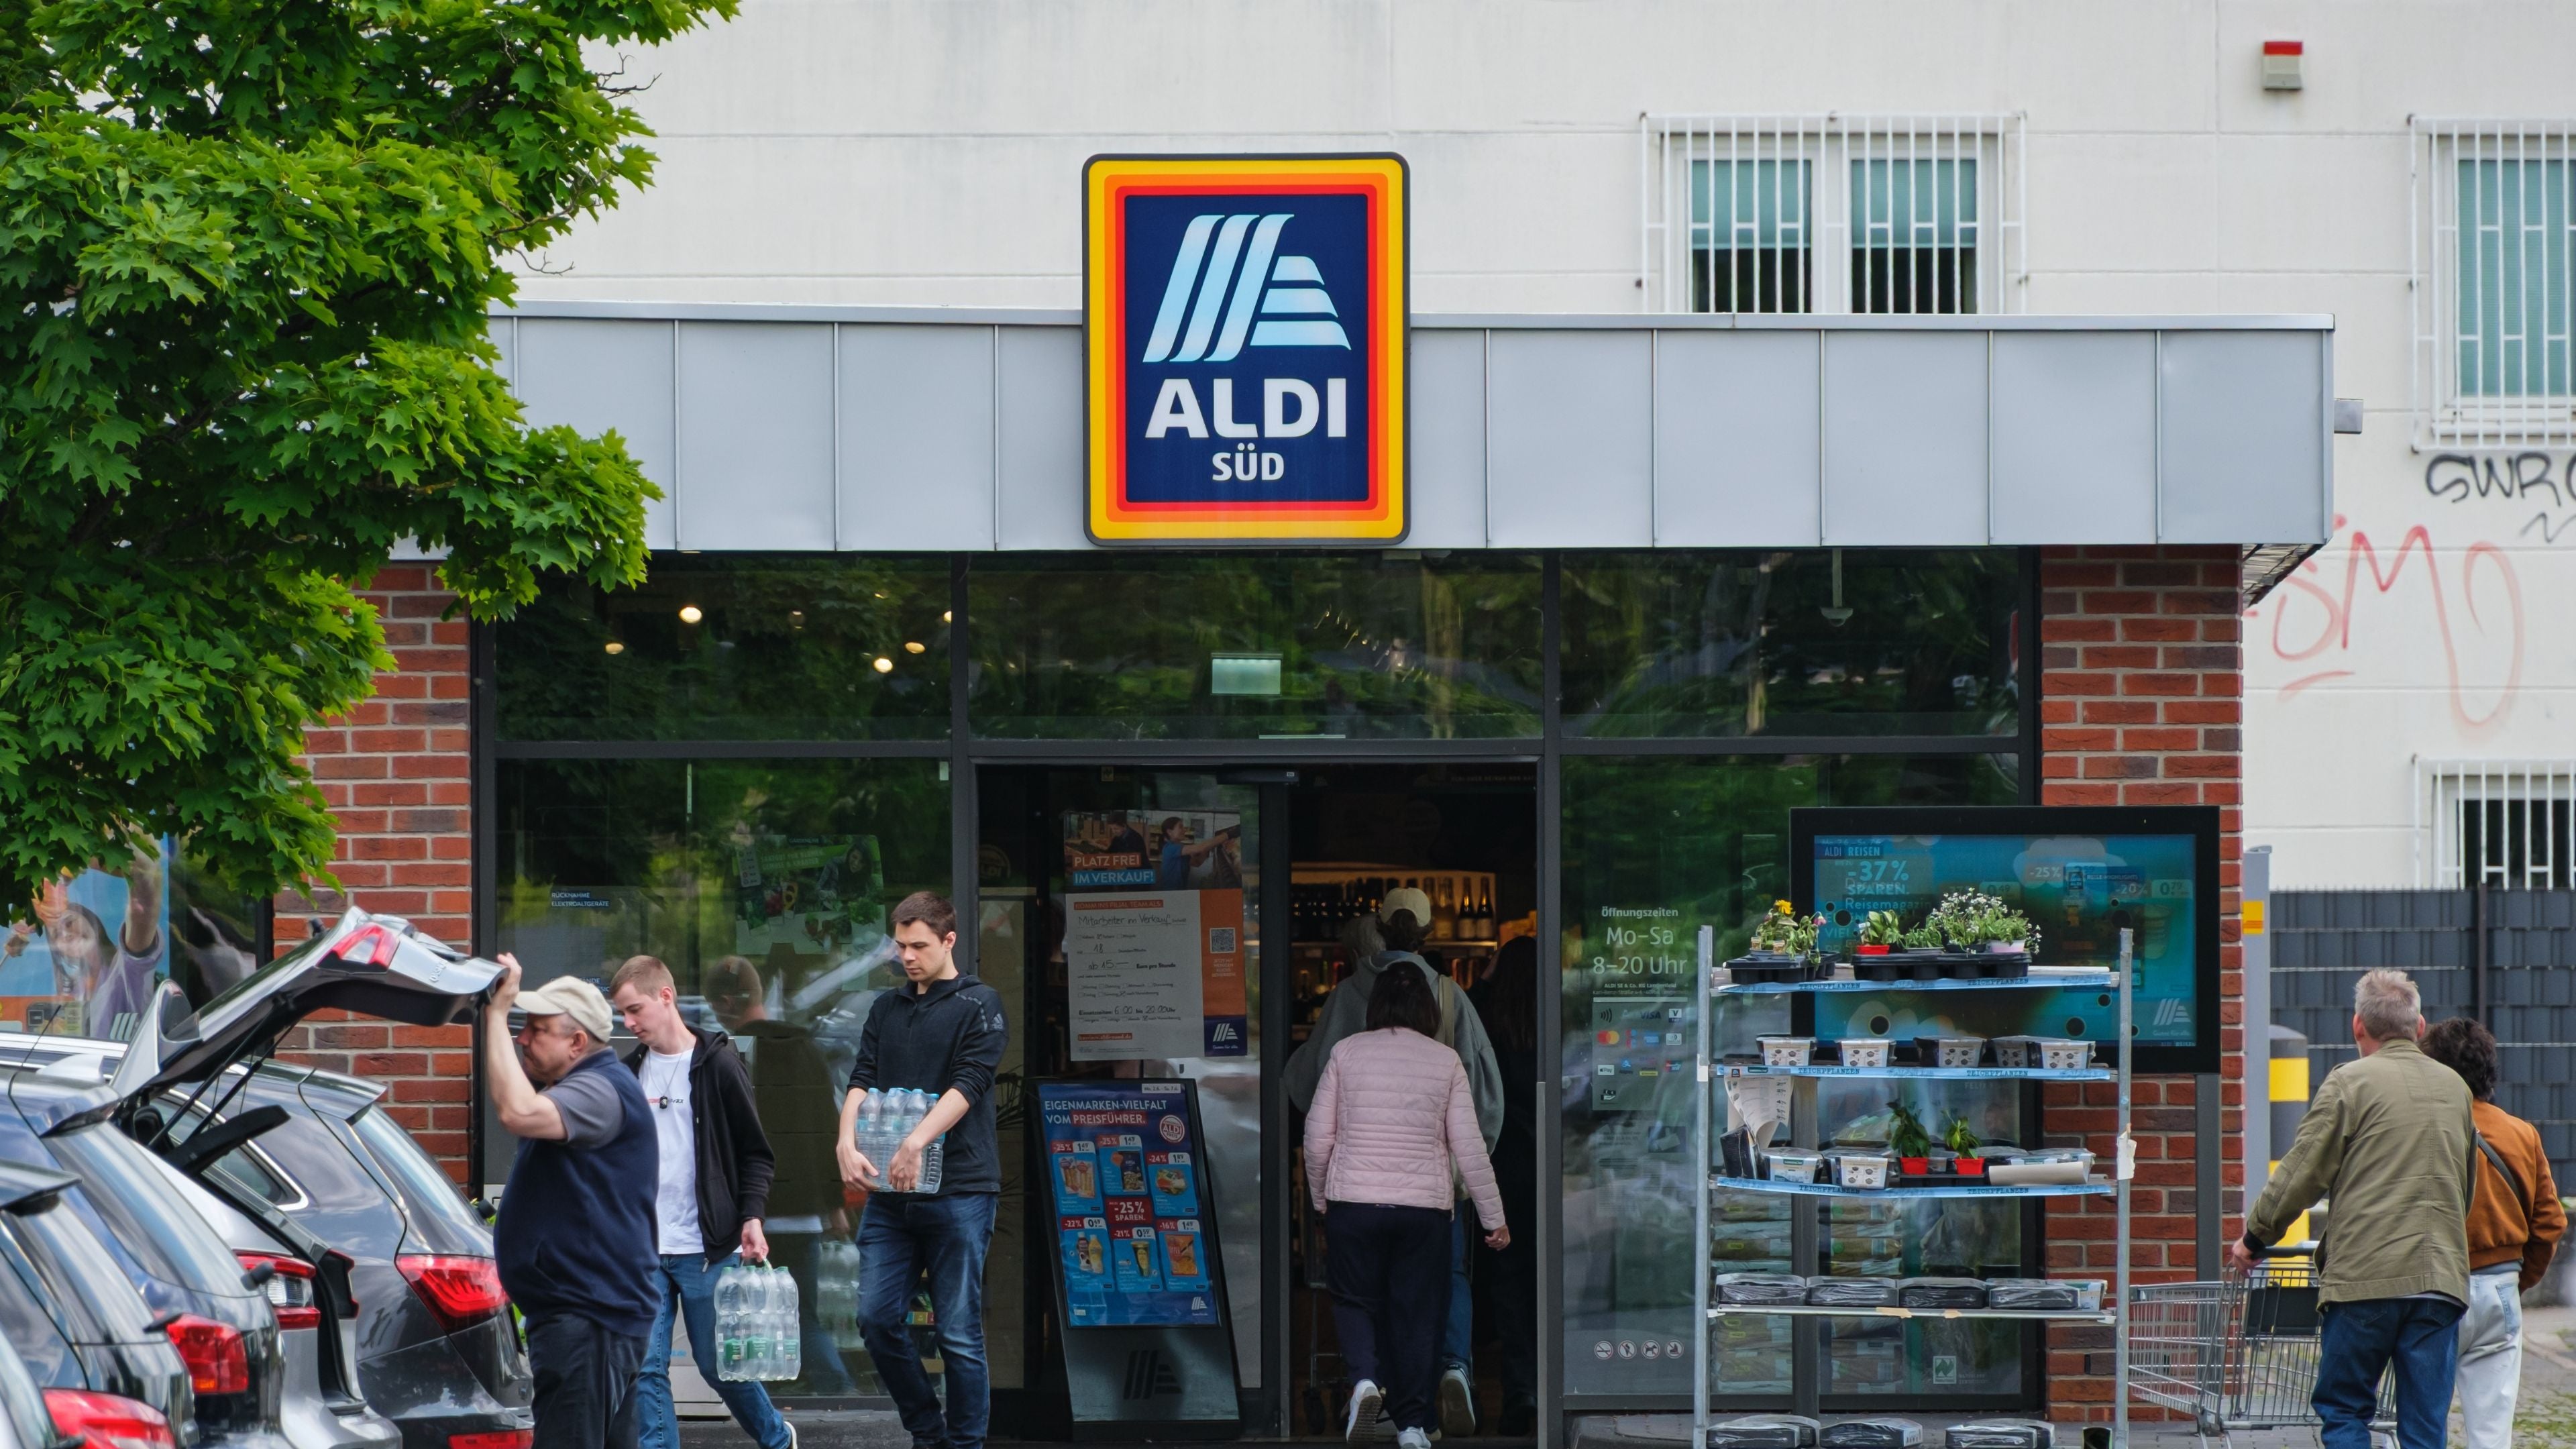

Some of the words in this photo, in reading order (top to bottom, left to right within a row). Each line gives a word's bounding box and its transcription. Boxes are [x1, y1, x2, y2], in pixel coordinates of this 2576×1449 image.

[1144, 378, 1346, 437] ALDI
[1212, 443, 1284, 480] SÜD
[1825, 847, 1841, 856] ALDI
[1848, 847, 1880, 856] REISEN
[1074, 855, 1110, 867] PLATZ
[1113, 855, 1140, 866] FREI
[1075, 873, 1089, 883] IM
[1092, 871, 1154, 883] VERKAUF!
[1848, 883, 1909, 895] SPAREN.
[1845, 898, 1931, 910] Reisemagazin
[1601, 907, 1678, 919] Öffnungszeiten
[1078, 916, 1124, 926] Mitarbeiter
[1138, 914, 1170, 926] Verkauf
[1093, 944, 1104, 953] 18
[1088, 961, 1098, 970] ab
[1650, 955, 1688, 974] Uhr
[1799, 983, 1860, 991] TEICHPFLANZEN
[1967, 978, 2029, 986] TEICHPFLANZEN
[1044, 1100, 1167, 1110] EIGENMARKEN-VIELFALT
[1046, 1115, 1071, 1124] VOM
[1073, 1112, 1145, 1124] PREISFÜHRER.
[1799, 1185, 1860, 1194] TEICHPFLANZEN
